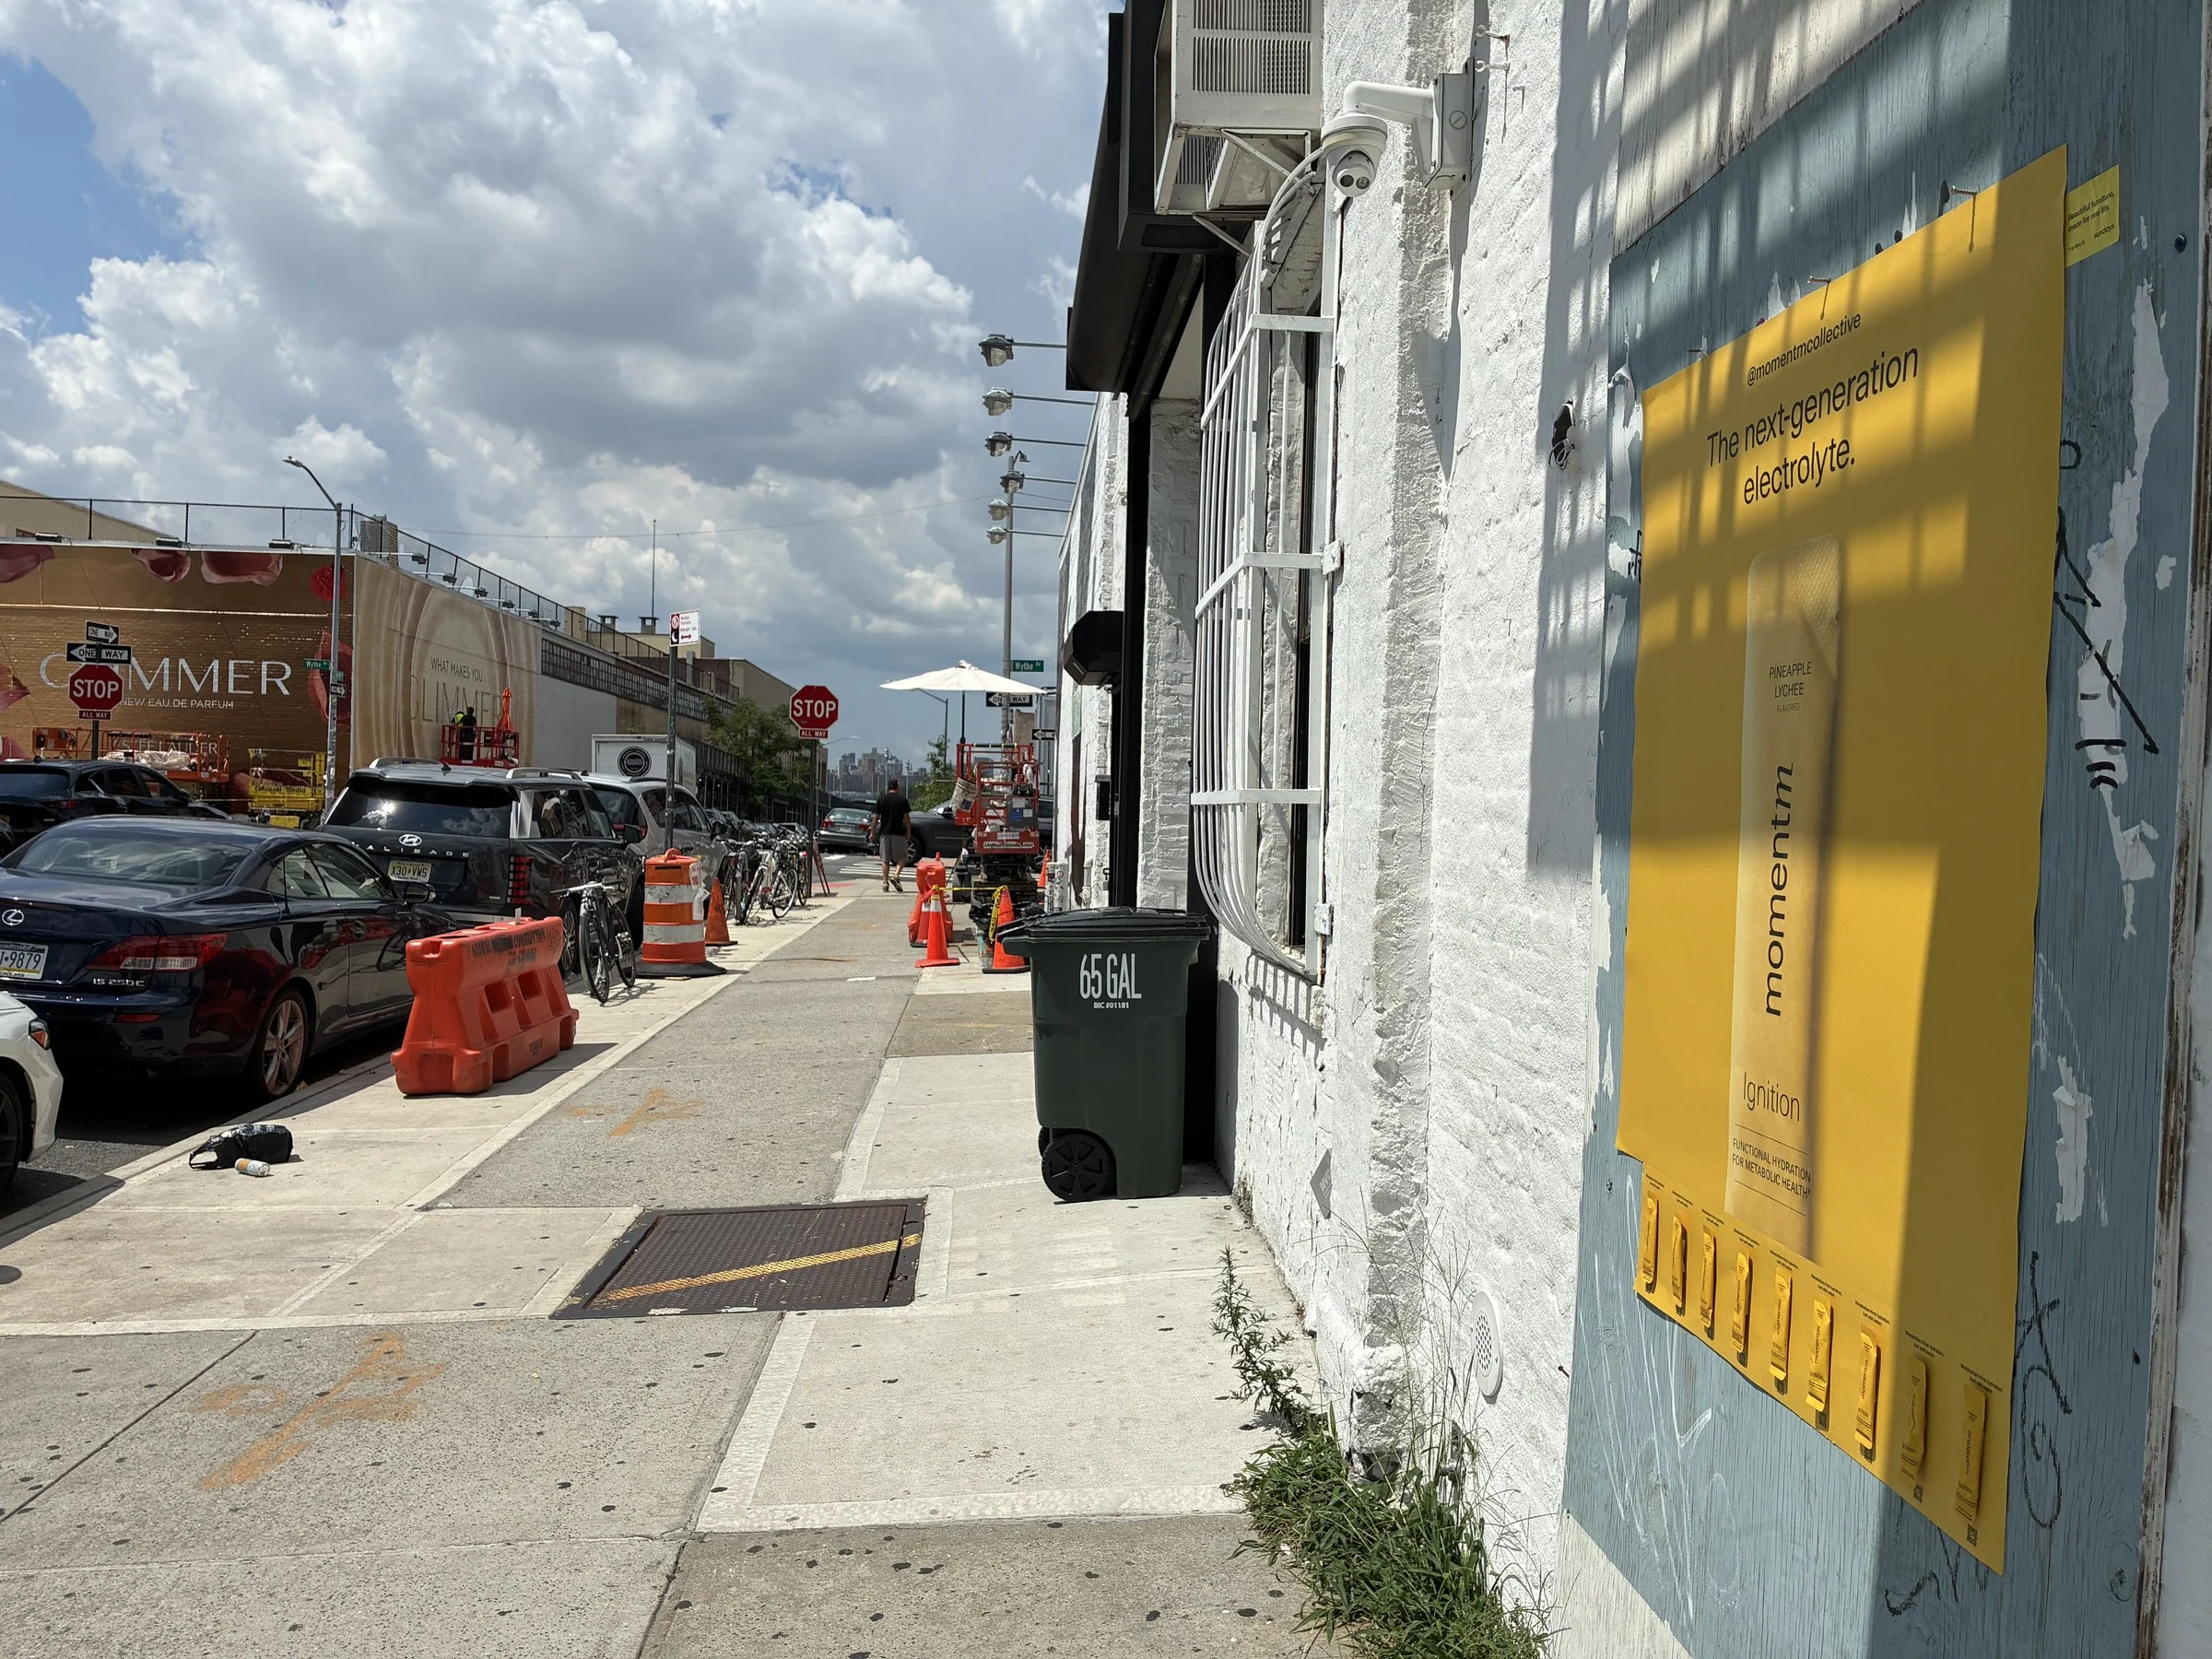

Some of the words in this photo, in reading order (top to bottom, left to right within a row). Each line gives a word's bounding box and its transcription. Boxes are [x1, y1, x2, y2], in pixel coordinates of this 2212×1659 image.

[2094, 223, 2115, 240] sundays
[1747, 313, 1861, 386] @momentmcollective
[1708, 429, 1739, 467] The
[1746, 347, 1919, 452] next-generation
[1744, 438, 1855, 505] electrolyte.
[89, 628, 100, 637] ONE
[104, 630, 114, 640] WAY
[78, 649, 97, 658] ONE
[105, 651, 124, 659] WAY
[431, 657, 450, 672] WHAT
[451, 662, 470, 679] MAKES
[471, 667, 483, 682] YOU
[1015, 662, 1034, 672] Wythe
[1769, 661, 1812, 680] PINEAPPLE
[73, 679, 119, 700] STOP
[1011, 695, 1027, 703] WAY
[1774, 683, 1805, 699] LYCHEE
[148, 699, 171, 708] EAU
[173, 700, 188, 709] DE
[190, 700, 234, 710] PARFUM
[793, 699, 837, 719] STOP
[1777, 702, 1800, 713] FLAVORED
[352, 841, 470, 858] ALISADE
[1766, 762, 1794, 1017] momentm
[1079, 953, 1102, 1000] 65
[1107, 953, 1142, 1000] GAL
[1744, 1072, 1800, 1123] Ignition
[1732, 1153, 1745, 1169] FOR
[1745, 1159, 1781, 1186] METABOLIC
[1733, 1138, 1771, 1165] FUNCTIONAL
[1772, 1155, 1811, 1182] HYDRATION
